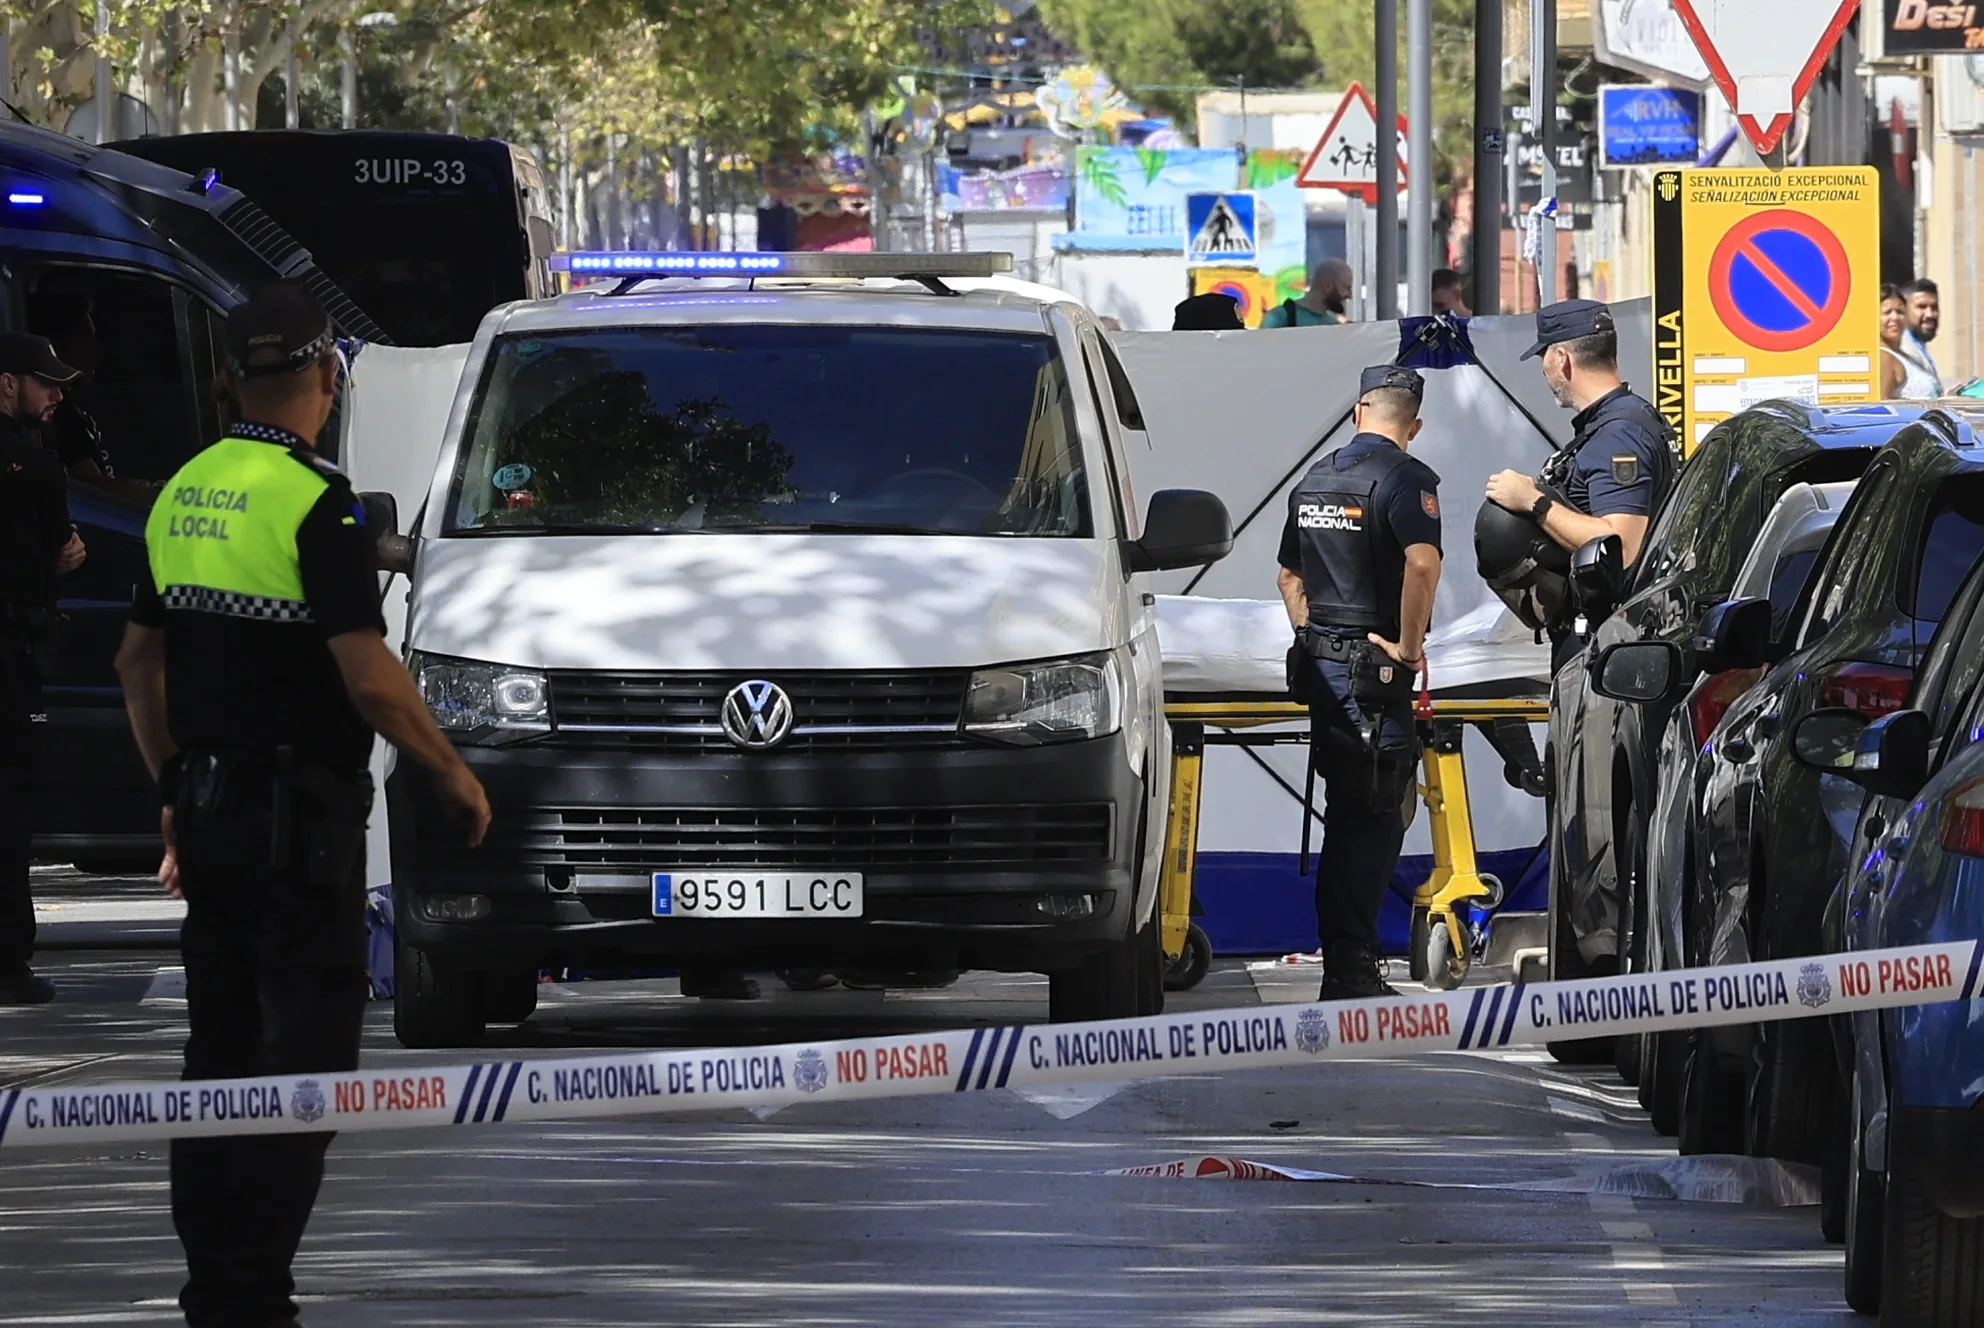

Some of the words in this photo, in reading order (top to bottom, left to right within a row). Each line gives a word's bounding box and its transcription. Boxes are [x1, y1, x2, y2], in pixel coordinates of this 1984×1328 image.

[354, 159, 466, 184] 3UIP-33
[1689, 174, 1781, 187] SENYALITZACIÓ
[1787, 174, 1869, 187] EXCEPCIONAL
[1690, 189, 1778, 203] SEÑALIZACIÓN
[1779, 189, 1861, 202] EXCEPCIONAL
[171, 486, 249, 513] POLICIA
[1298, 505, 1346, 517] POLICIA
[169, 515, 230, 540] LOCAL
[1298, 517, 1362, 531] NACIONAL
[679, 879, 766, 911] 9591
[785, 879, 852, 911] LCC
[1531, 994, 1551, 1028] C.
[1558, 983, 1664, 1025] NACIONAL
[1670, 979, 1698, 1015] DE
[1704, 971, 1789, 1012] POLICIA
[1839, 962, 1871, 997] NO
[1878, 954, 1953, 993] PASAR
[1029, 1035, 1050, 1069] C.
[1056, 1026, 1162, 1067] NACIONAL
[1168, 1024, 1195, 1058] DE
[1202, 1017, 1287, 1056] POLICIA
[1338, 1010, 1369, 1044] NO
[1376, 1003, 1450, 1041] PASAR
[528, 1070, 548, 1103] C.
[554, 1063, 661, 1101] NACIONAL
[668, 1061, 695, 1094] DE
[702, 1056, 785, 1093] POLICIA
[836, 1049, 868, 1084] NO
[875, 1043, 948, 1080] PASAR
[26, 1098, 45, 1129] C.
[52, 1092, 158, 1128] NACIONAL
[165, 1090, 192, 1123] DE
[199, 1086, 283, 1122] POLICIA
[335, 1080, 365, 1113] NO
[373, 1076, 446, 1111] PASAR
